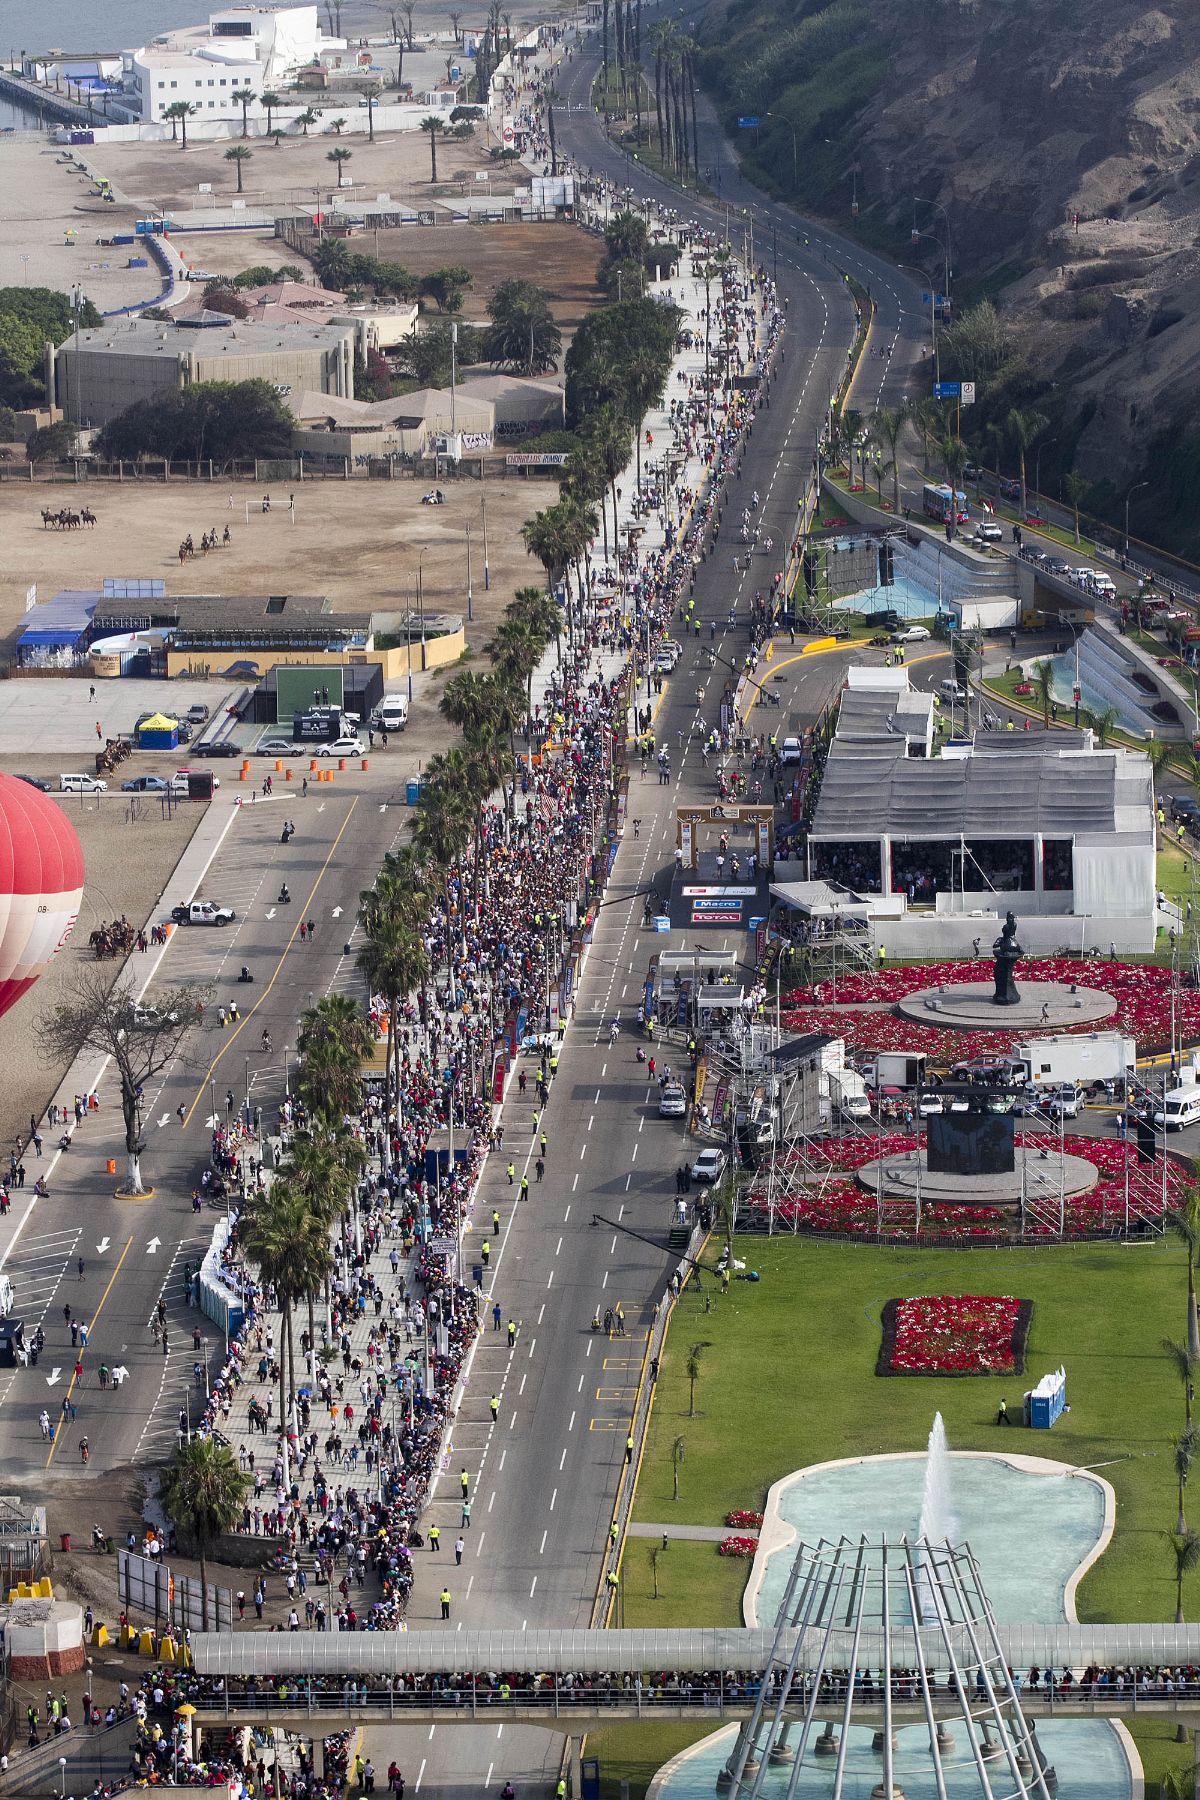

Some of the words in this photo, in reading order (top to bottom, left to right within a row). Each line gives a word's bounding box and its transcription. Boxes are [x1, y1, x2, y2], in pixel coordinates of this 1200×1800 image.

[508, 455, 541, 463] CHORRILLOS
[543, 455, 562, 463] RUMBO
[716, 1089, 725, 1116] TOTAL
